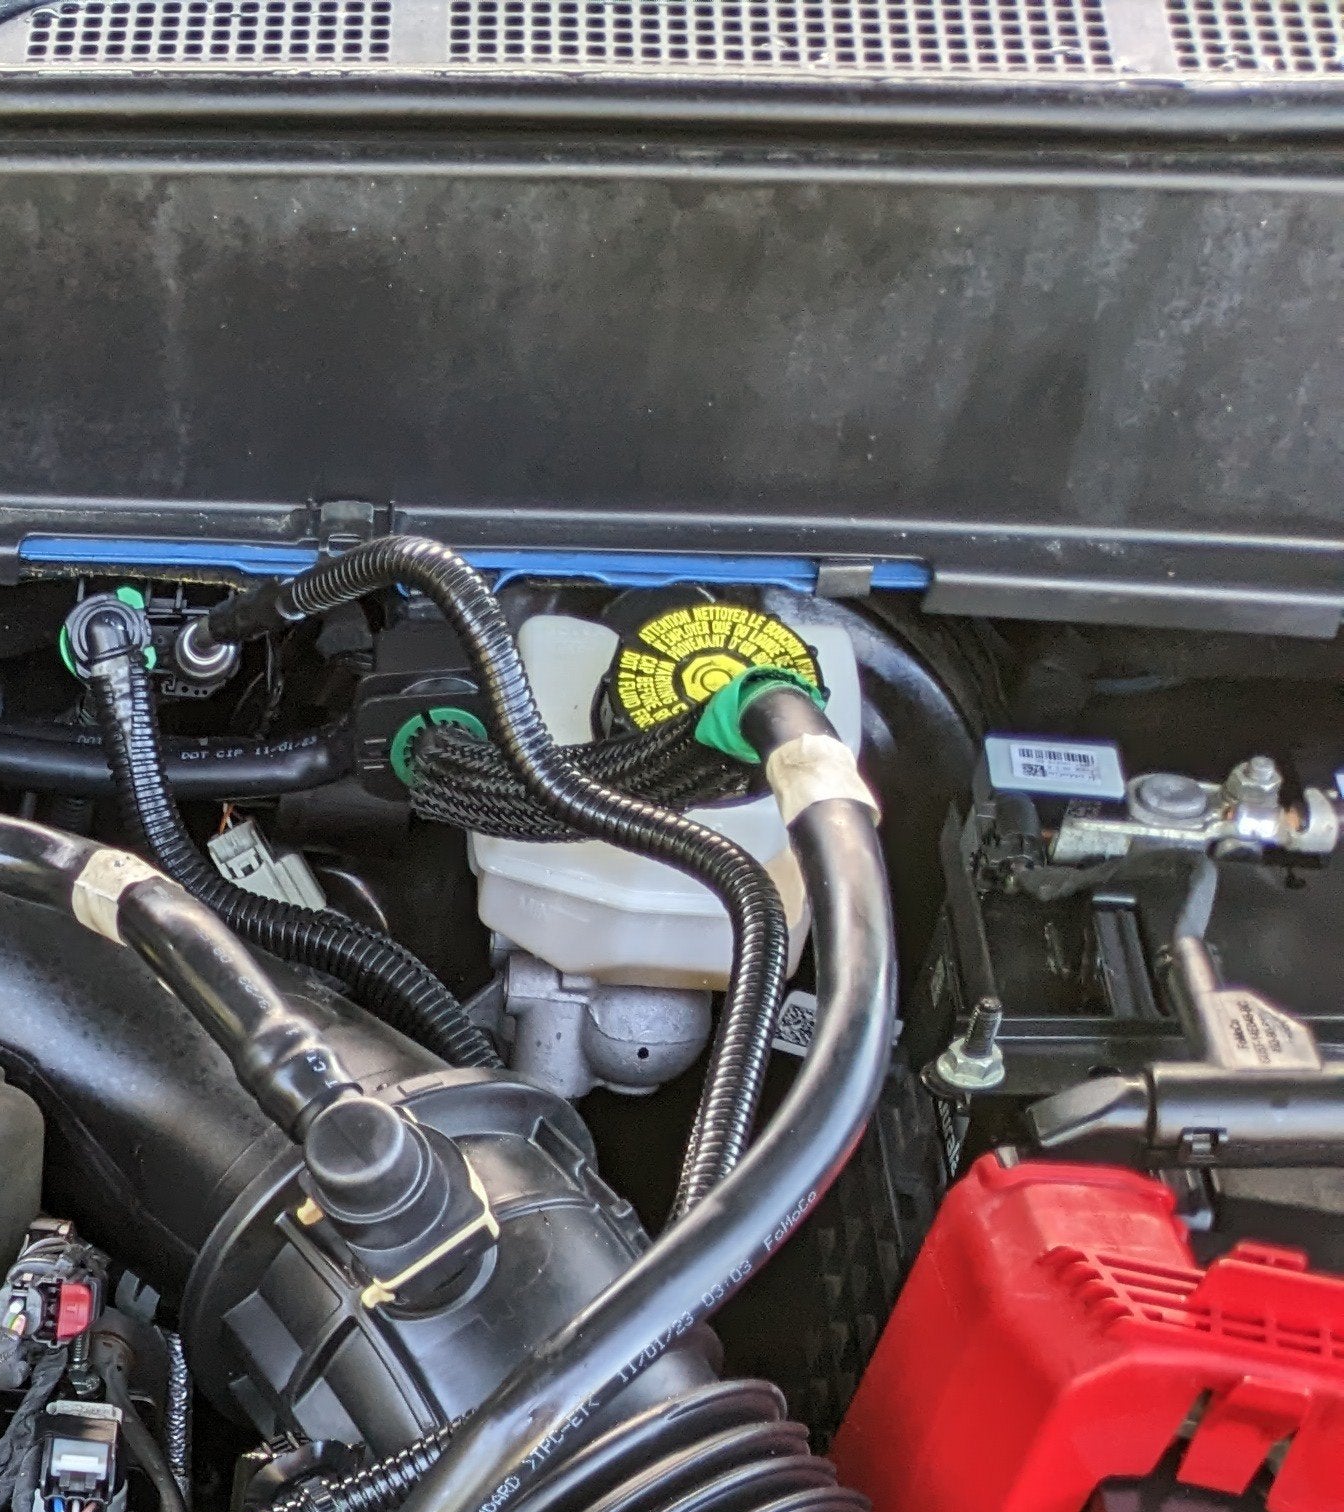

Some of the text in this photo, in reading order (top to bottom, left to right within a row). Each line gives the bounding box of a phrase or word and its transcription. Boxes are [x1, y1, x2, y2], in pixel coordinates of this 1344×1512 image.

[638, 609, 692, 645] ATTENTION
[692, 605, 750, 624] NETTOYER
[747, 613, 767, 629] LE
[711, 619, 732, 635] QUE
[618, 671, 636, 679] 4
[619, 650, 641, 672] DOT
[638, 655, 659, 674] CAP
[618, 681, 641, 709] FLUID
[635, 676, 663, 712] BEFORE
[654, 660, 679, 705] WARNING
[616, 1310, 696, 1384] 11/01/23
[700, 1258, 754, 1309] 03:03
[763, 1190, 819, 1252] FoMoCo
